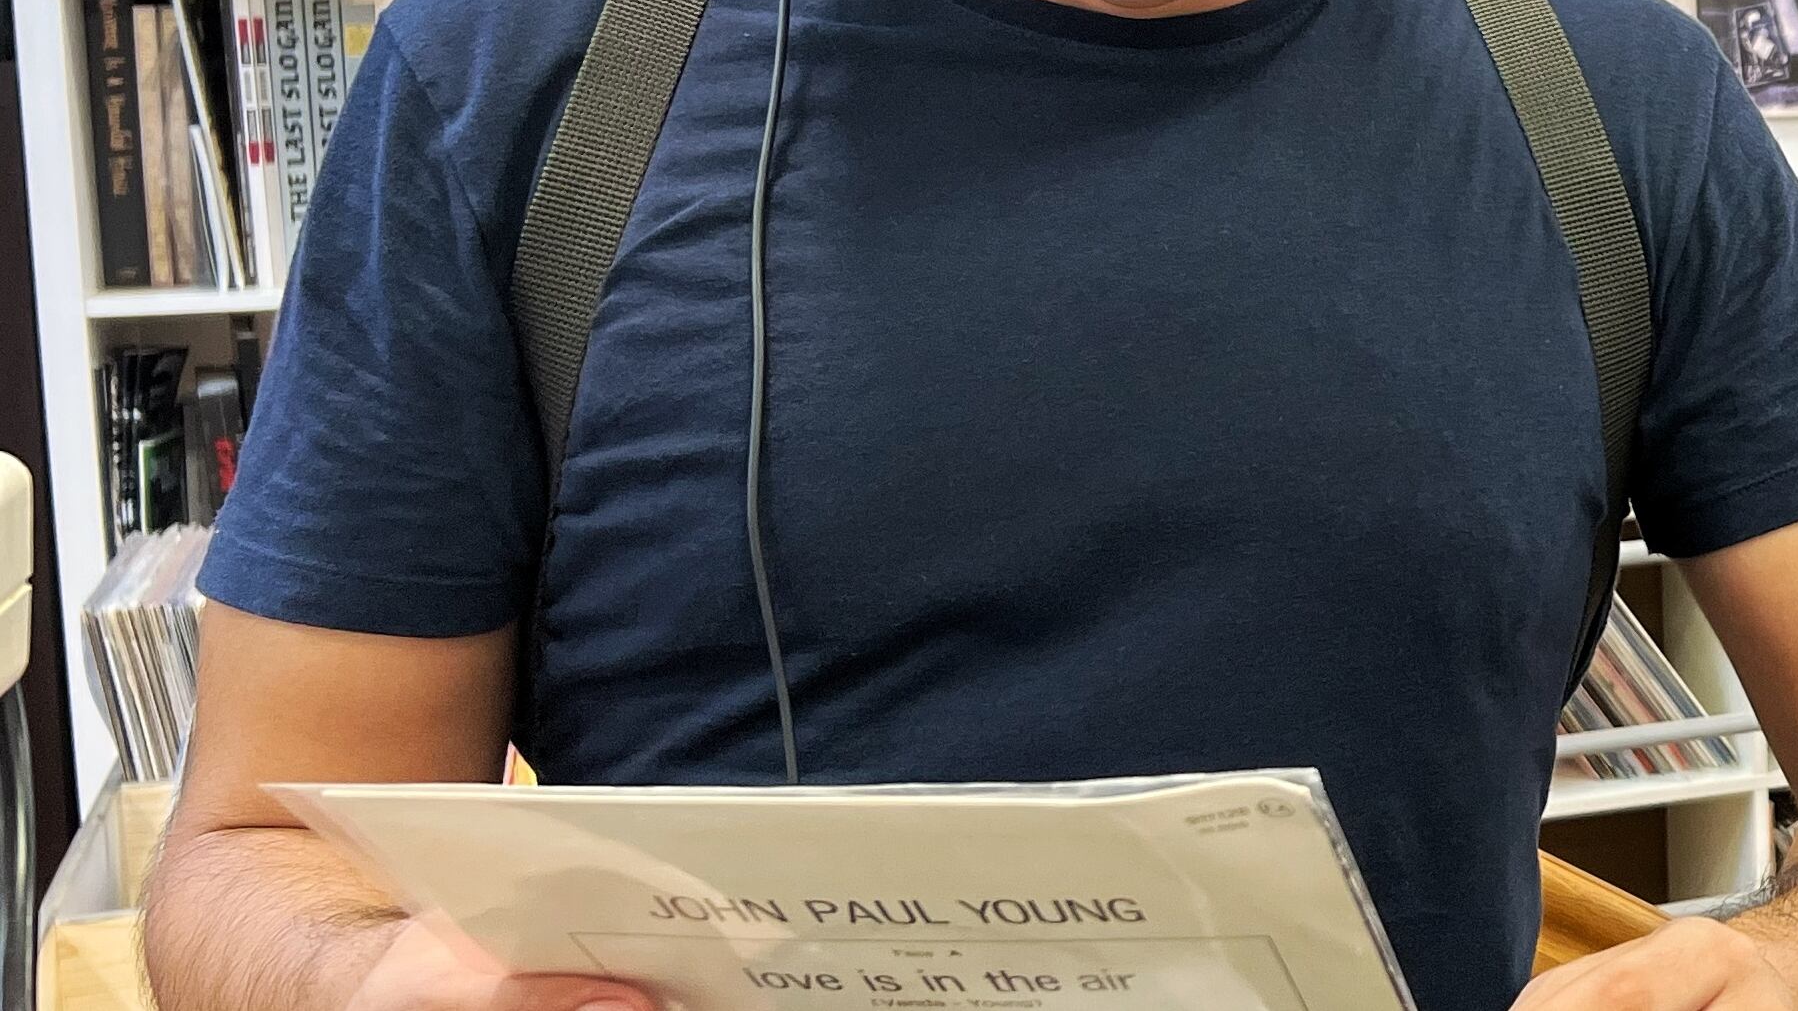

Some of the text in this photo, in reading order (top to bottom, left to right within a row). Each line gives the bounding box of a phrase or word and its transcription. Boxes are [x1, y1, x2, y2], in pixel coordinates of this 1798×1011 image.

[281, 106, 306, 166] LAST
[649, 894, 1147, 925] JOHN PAUL YOUNG
[742, 966, 1137, 992] love is in the air
